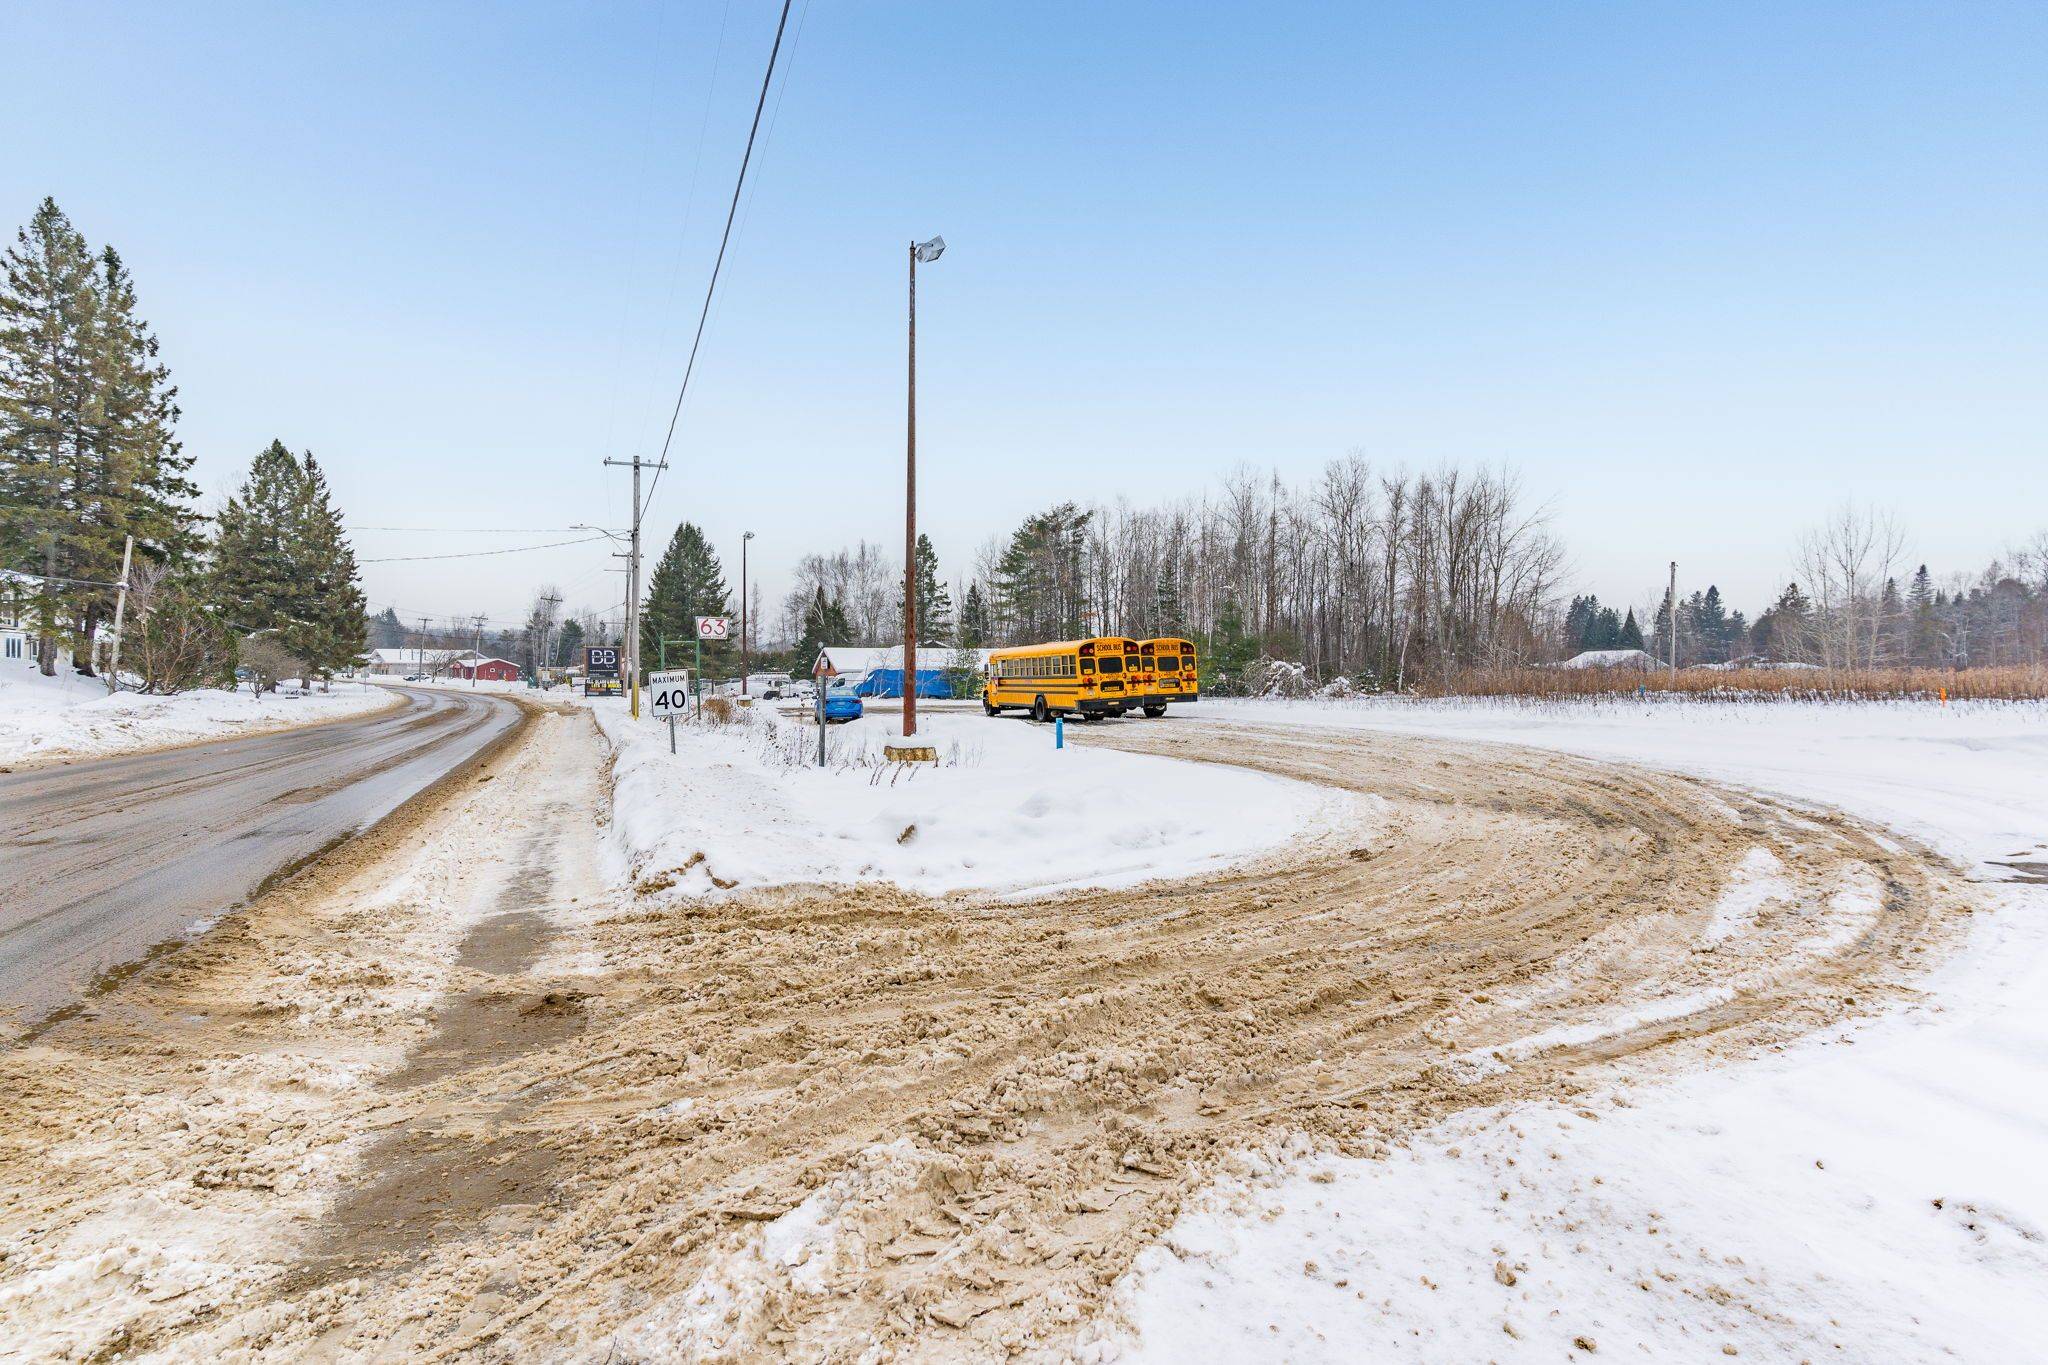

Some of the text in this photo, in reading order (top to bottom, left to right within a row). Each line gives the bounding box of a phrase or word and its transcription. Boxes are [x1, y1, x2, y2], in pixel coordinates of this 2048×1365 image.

[701, 618, 725, 635] 63
[652, 675, 685, 684] MAXIMUM
[655, 690, 685, 709] 40
